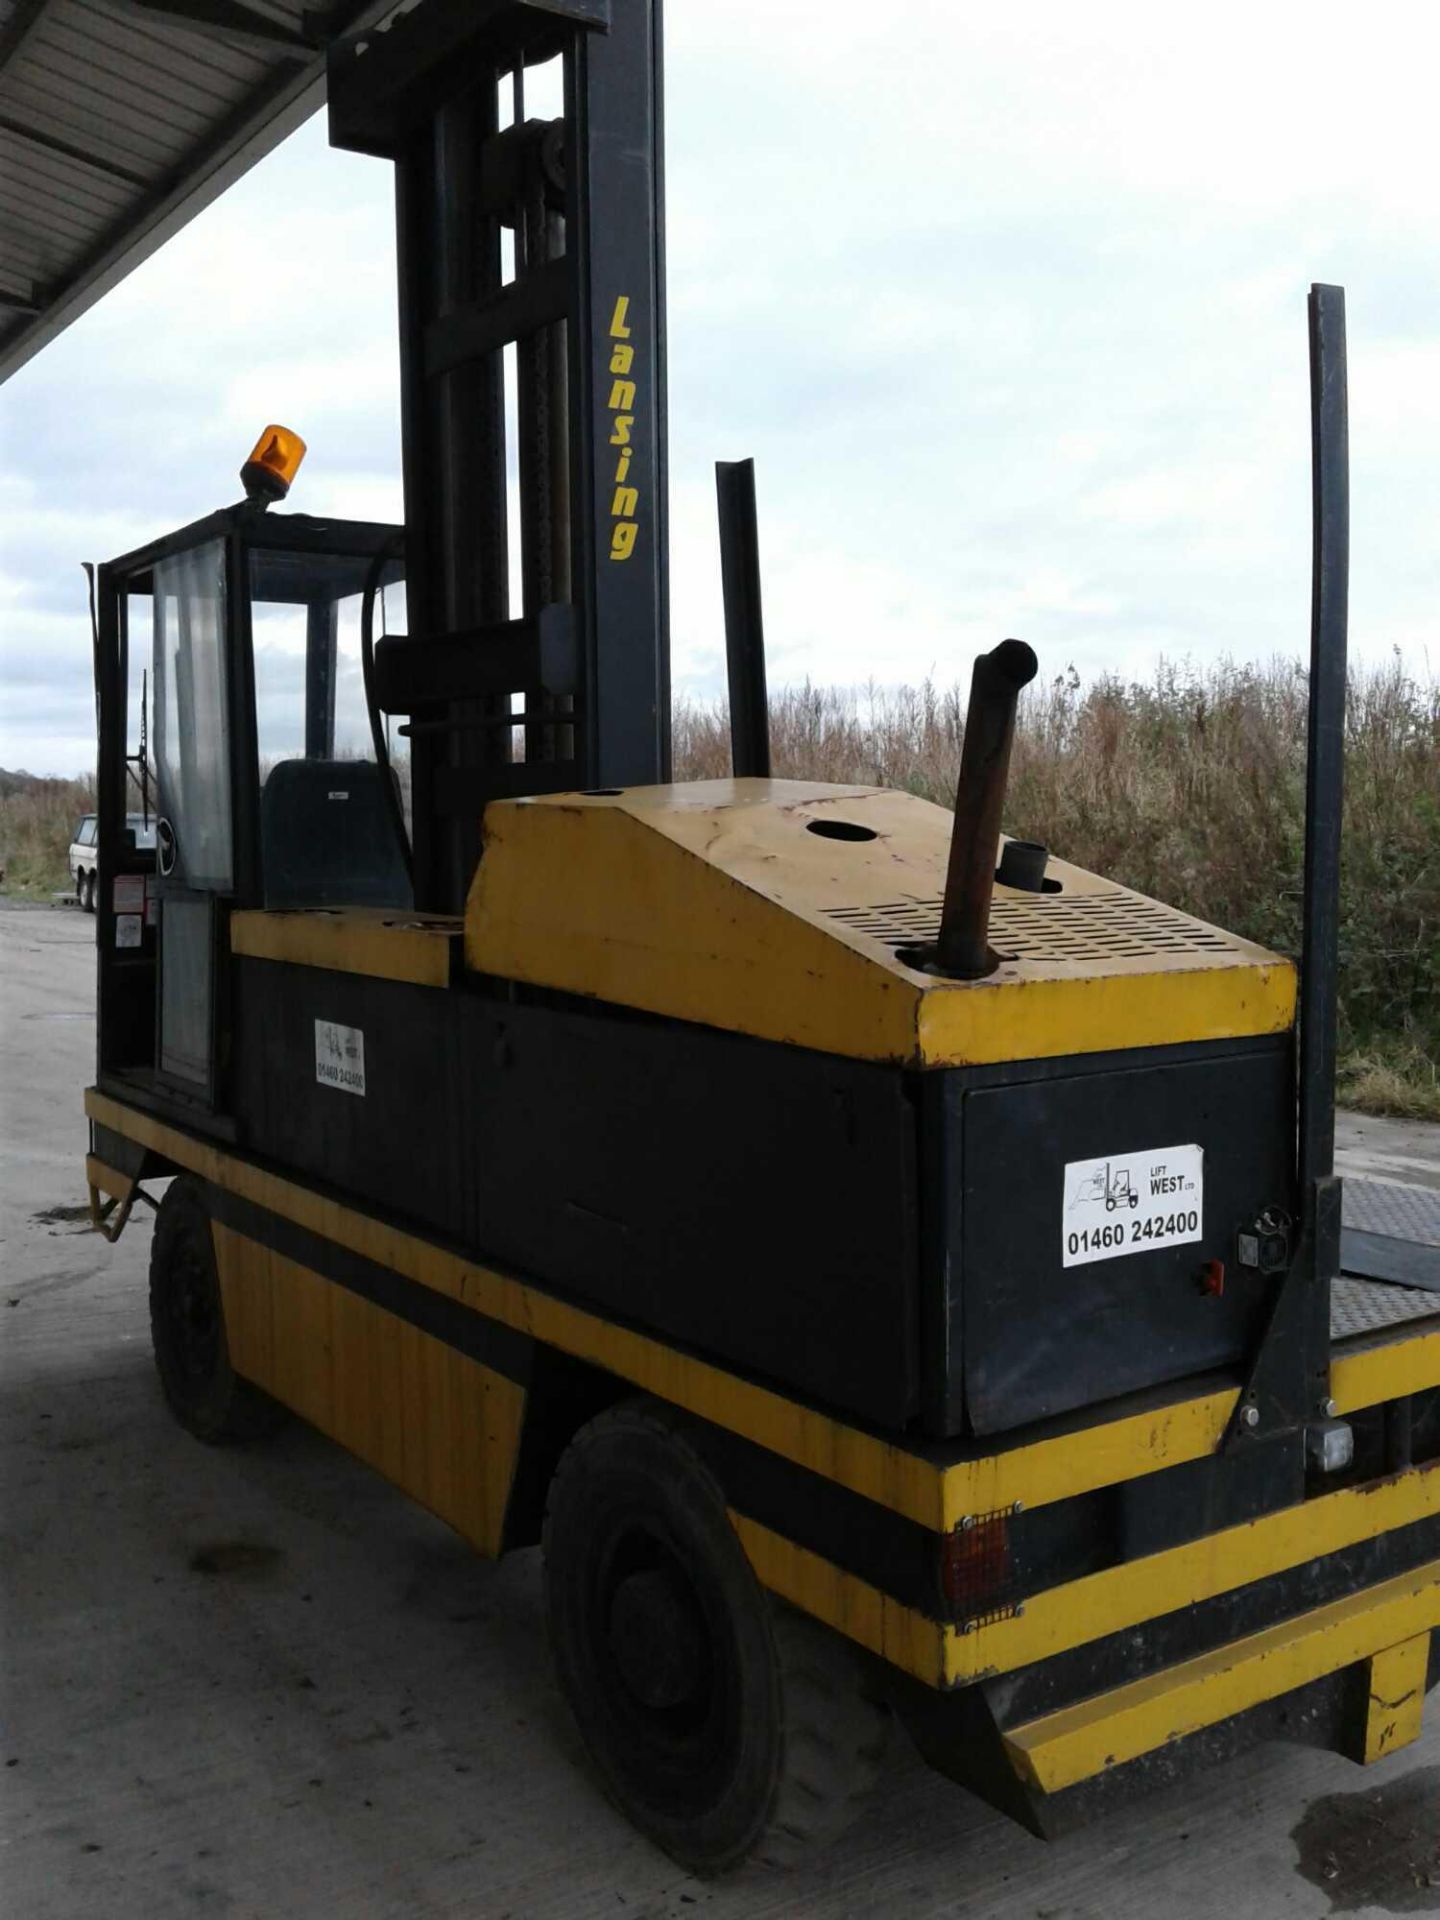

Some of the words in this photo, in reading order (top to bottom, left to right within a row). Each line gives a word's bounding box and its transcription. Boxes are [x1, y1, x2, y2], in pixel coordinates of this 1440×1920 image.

[608, 296, 639, 560] Lansing
[1150, 1165, 1166, 1177] LIFT
[1150, 1175, 1185, 1195] WEST
[1068, 1223, 1124, 1255] 01460
[1131, 1210, 1198, 1242] 242400
